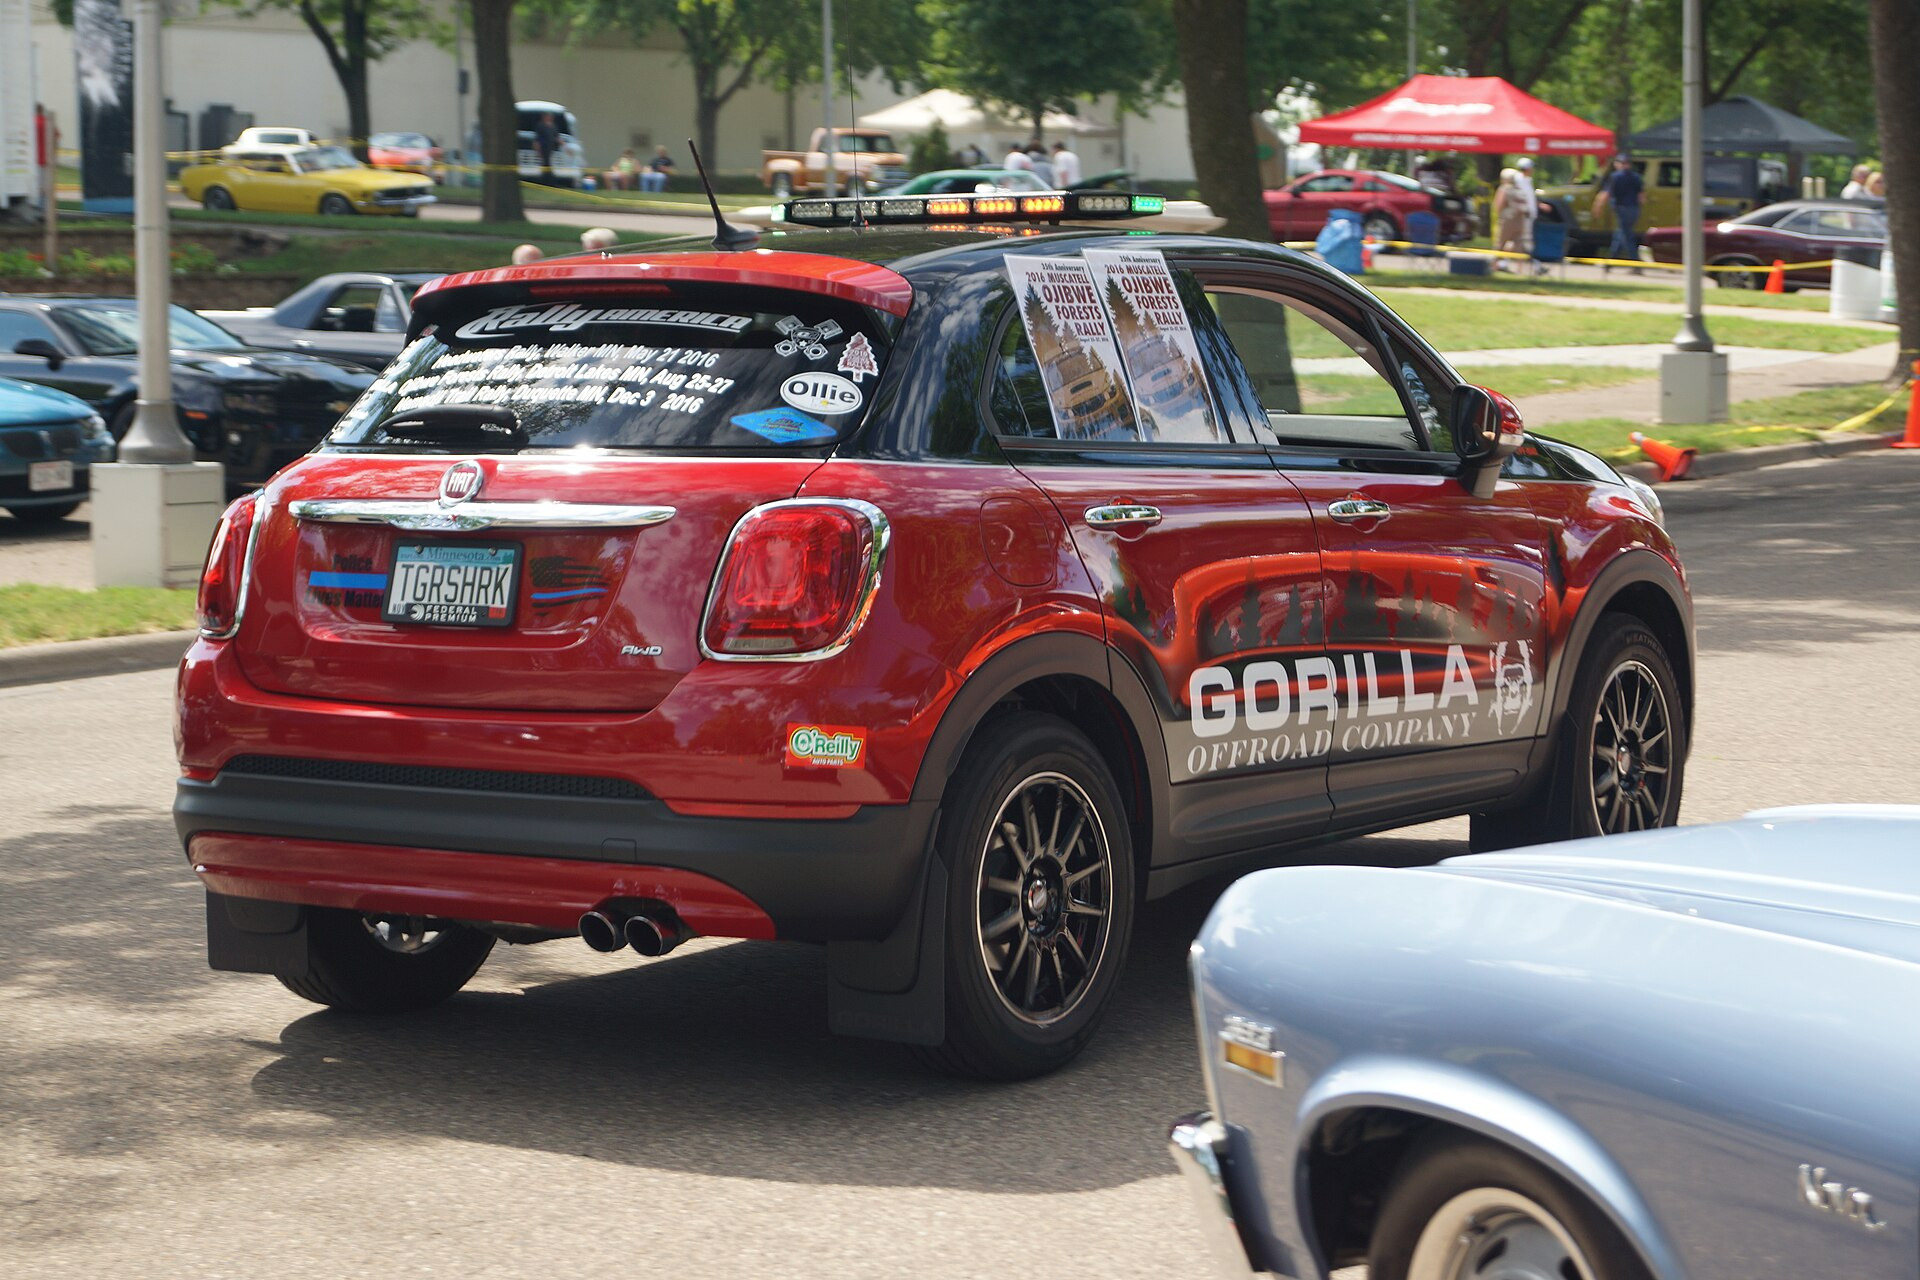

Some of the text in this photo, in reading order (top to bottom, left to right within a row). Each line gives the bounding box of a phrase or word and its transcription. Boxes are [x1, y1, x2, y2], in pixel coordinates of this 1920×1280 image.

[1055, 262, 1085, 273] Anniversary
[1132, 255, 1161, 265] Anniversary
[1025, 271, 1090, 284] 2016 MUSCATELL
[1104, 264, 1167, 276] 2016 MUSCATELL
[1042, 284, 1097, 304] OJIBWE
[1121, 276, 1174, 295] OJIBWE
[1135, 295, 1180, 310] FORESTS
[455, 303, 603, 338] Rally
[598, 309, 752, 330] AMERICA
[1055, 305, 1102, 320] FORESTS
[1154, 312, 1184, 326] RALLY
[1074, 322, 1106, 336] RALLY
[503, 344, 544, 362] Rally,
[544, 343, 596, 360] Walker
[593, 344, 624, 361] MN,
[624, 345, 658, 364] May
[656, 347, 681, 362] 21
[677, 350, 720, 367] 2016
[486, 364, 525, 383] Rally,
[525, 363, 577, 379] Detroit
[574, 364, 622, 381] Lakes
[619, 365, 652, 385] MN,
[650, 368, 687, 390] Aug
[684, 372, 735, 394] 25-27
[511, 385, 578, 403] Duquette
[575, 385, 609, 405] MN,
[607, 387, 642, 405] Dec
[640, 390, 656, 407] 3
[660, 392, 704, 414] 2016
[788, 380, 856, 404] Ollie
[446, 472, 475, 493] FIAT
[333, 554, 373, 571] Police
[401, 564, 509, 606] TGRSHRK
[304, 588, 341, 606] Lives
[425, 613, 477, 623] PREMIUM
[426, 604, 478, 615] FEDERAL
[621, 645, 662, 656] AWD
[1189, 645, 1479, 738] GORILLA
[794, 730, 859, 759] O'Reilly
[1187, 712, 1478, 775] OFFROAD COMPANY
